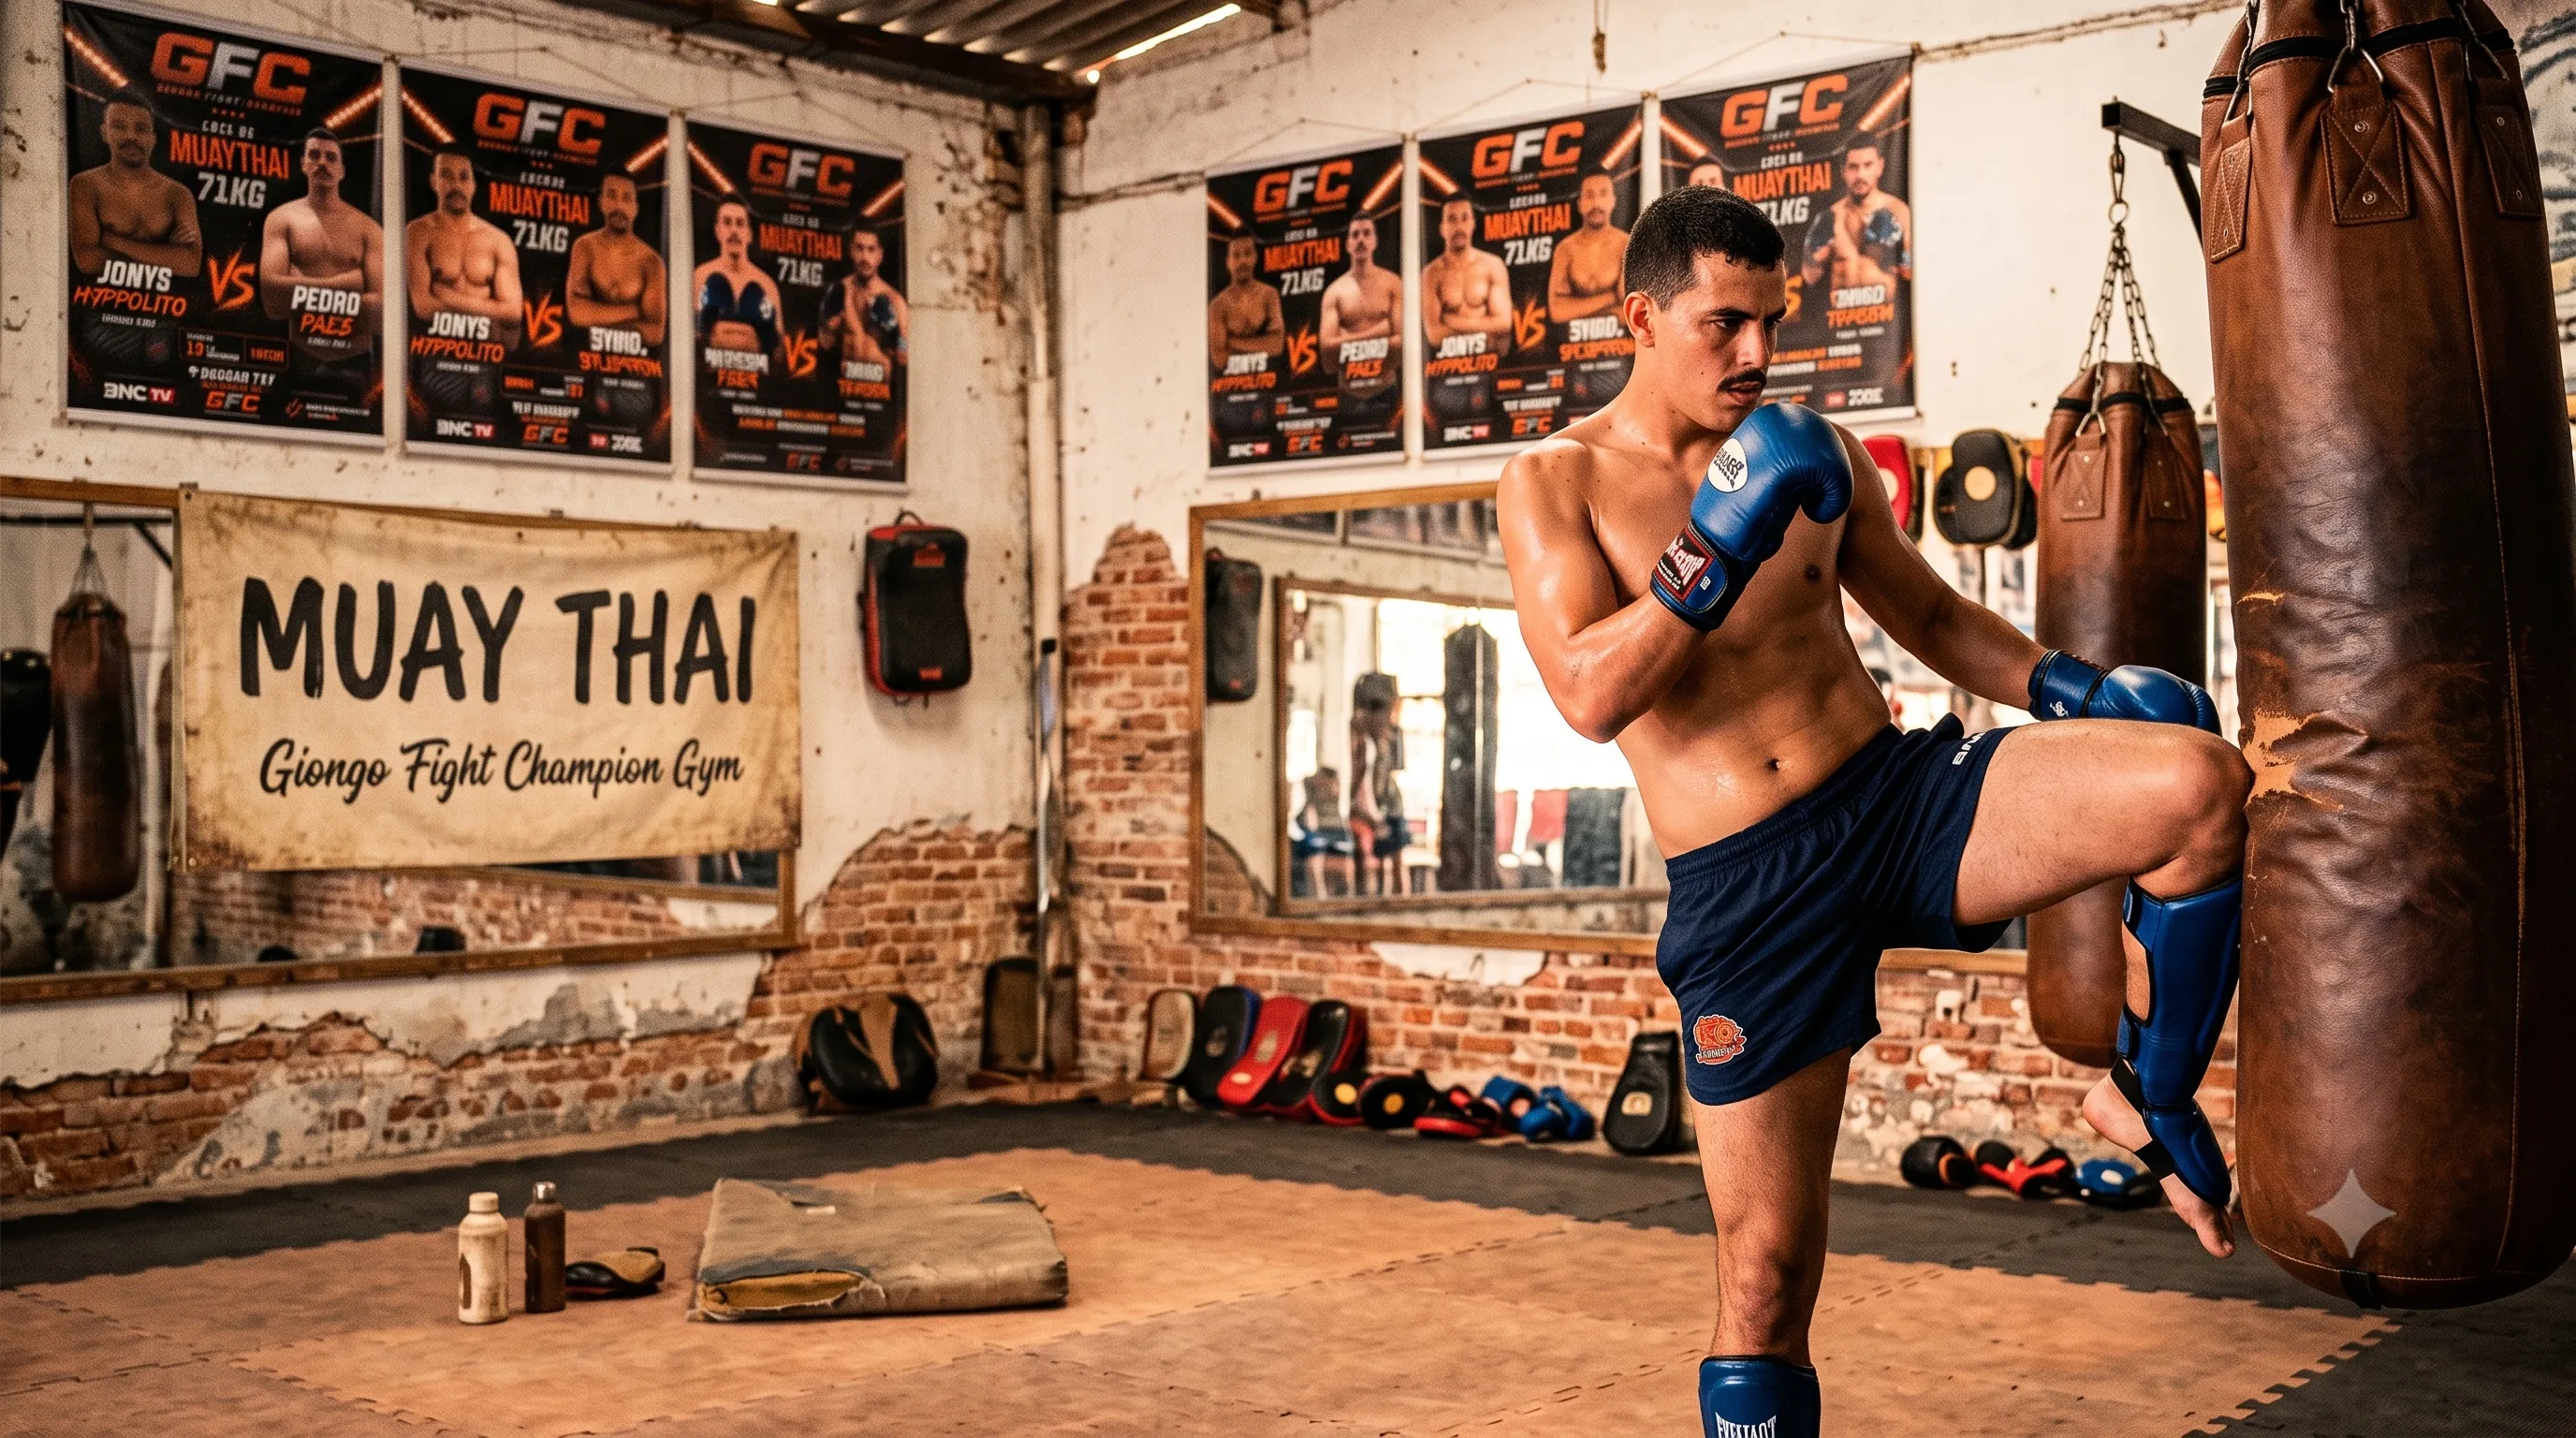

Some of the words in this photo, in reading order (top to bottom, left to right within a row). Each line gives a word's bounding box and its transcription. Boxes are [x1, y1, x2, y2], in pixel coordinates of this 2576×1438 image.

[150, 33, 312, 104] GFC
[473, 93, 607, 155] GFC
[1720, 74, 1849, 139] GFC
[169, 129, 289, 180] MUAYTHAI
[749, 142, 856, 198] GFC
[1471, 121, 1586, 179] GFC
[198, 170, 267, 210] 71KG
[489, 182, 591, 226] MUAYTHAI
[1253, 160, 1354, 214] GFC
[1734, 160, 1832, 203] MUAYTHAI
[513, 219, 569, 254] 71KG
[1484, 202, 1572, 242] MUAYTHAI
[1503, 236, 1553, 266] 71KG
[96, 259, 173, 293] JONYS
[206, 246, 256, 313] VS
[290, 285, 361, 316] PEDRO
[428, 311, 491, 340] JONYS
[522, 290, 564, 349] VS
[1512, 298, 1546, 353] VS
[783, 330, 820, 378] VS
[1286, 327, 1319, 376] VS
[203, 389, 261, 414] GFC
[521, 423, 569, 445] GFC
[239, 576, 524, 704] MUAY
[553, 588, 756, 706] THAI
[258, 737, 390, 805] Giongo
[399, 737, 494, 804] Fight
[504, 739, 664, 800] Champion
[672, 738, 745, 797] Gym
